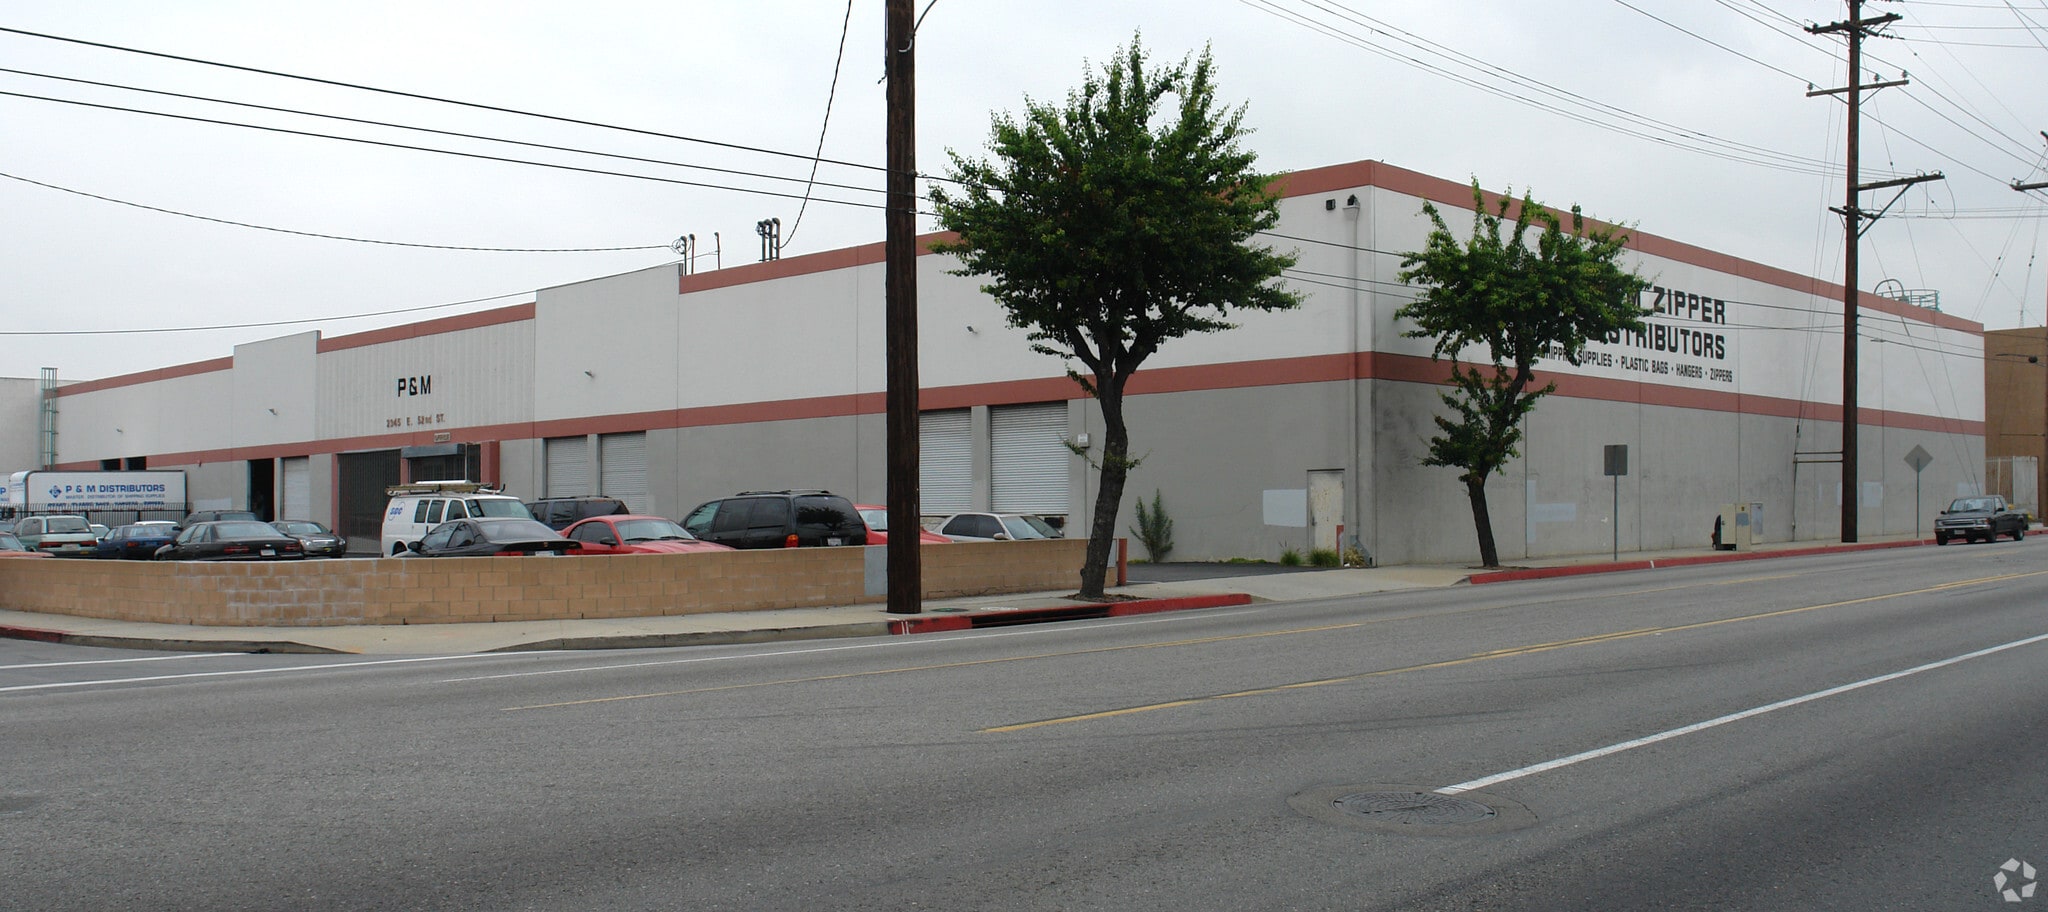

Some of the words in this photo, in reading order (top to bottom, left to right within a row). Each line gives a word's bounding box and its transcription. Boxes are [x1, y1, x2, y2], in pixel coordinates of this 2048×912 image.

[1653, 286, 1726, 325] ZIPPER
[1608, 321, 1726, 360] STRIBUTORS
[1578, 349, 1613, 367] SUPPLIES
[1620, 355, 1649, 372] PLASTIC
[1651, 360, 1669, 375] BAGS
[1676, 363, 1703, 379] HANGERS
[1709, 367, 1733, 383] ZIPPERS
[65, 485, 72, 493] P
[75, 484, 83, 493] &
[86, 484, 96, 493] M
[99, 484, 165, 493] DISTRIBUTORS
